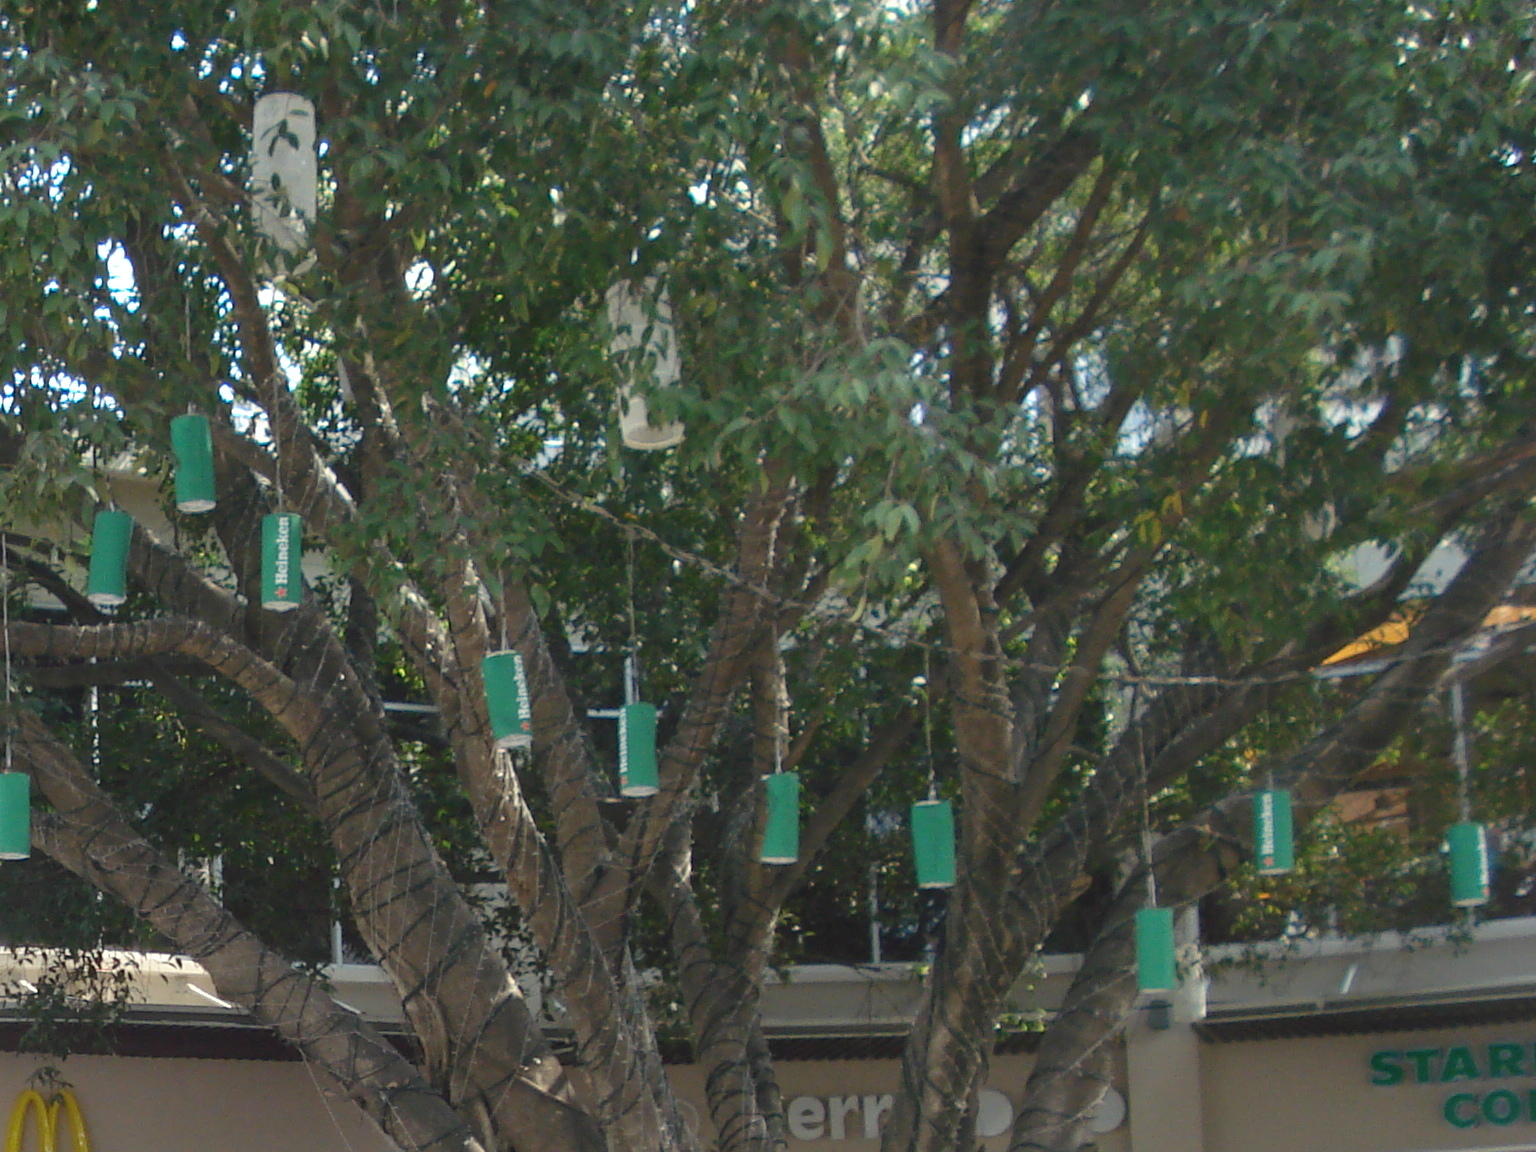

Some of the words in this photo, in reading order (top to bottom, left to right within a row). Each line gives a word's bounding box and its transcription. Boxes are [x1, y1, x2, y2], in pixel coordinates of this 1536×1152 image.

[274, 515, 289, 585] Heineken
[1370, 1042, 1536, 1087] STAR
[1443, 1088, 1536, 1129] CO
